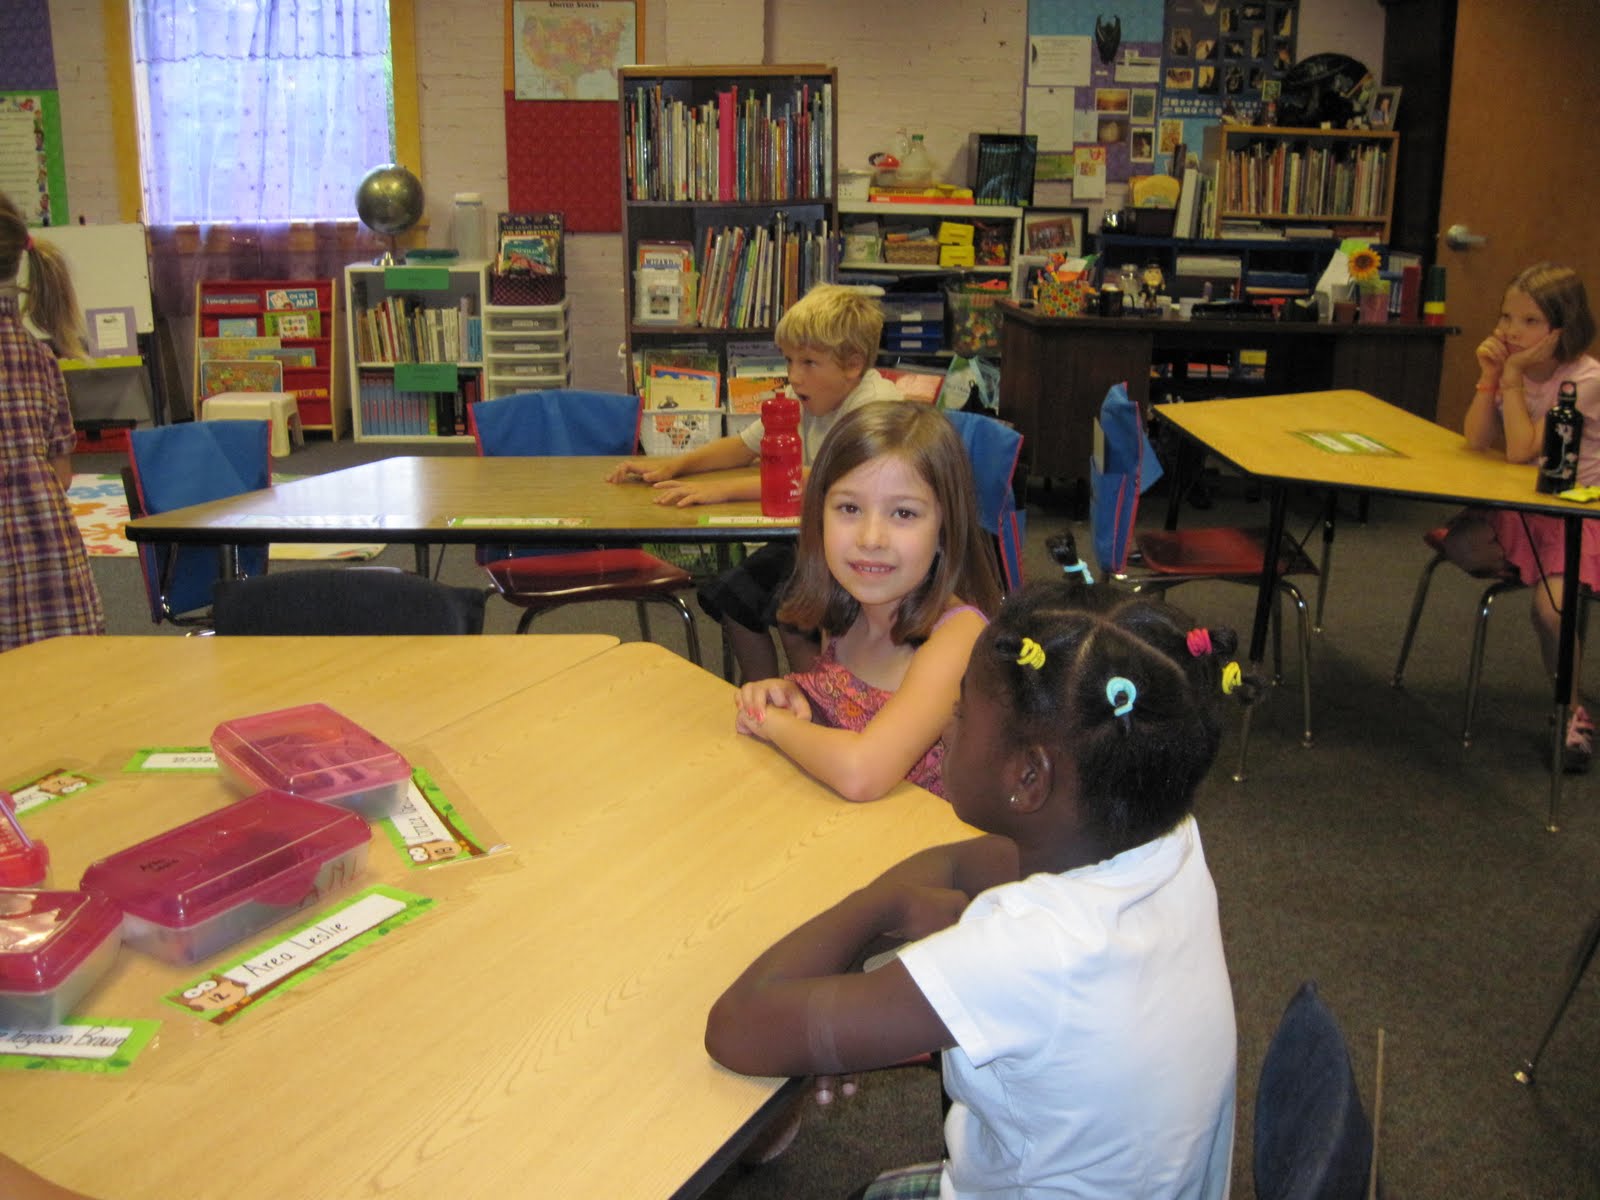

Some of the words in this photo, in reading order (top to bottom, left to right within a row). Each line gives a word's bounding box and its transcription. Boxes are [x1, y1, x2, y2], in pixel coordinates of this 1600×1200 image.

[296, 298, 314, 307] MAP
[242, 950, 296, 979] Area
[292, 920, 349, 954] Leslie
[208, 991, 230, 1004] 12
[74, 1025, 128, 1048] Brown
